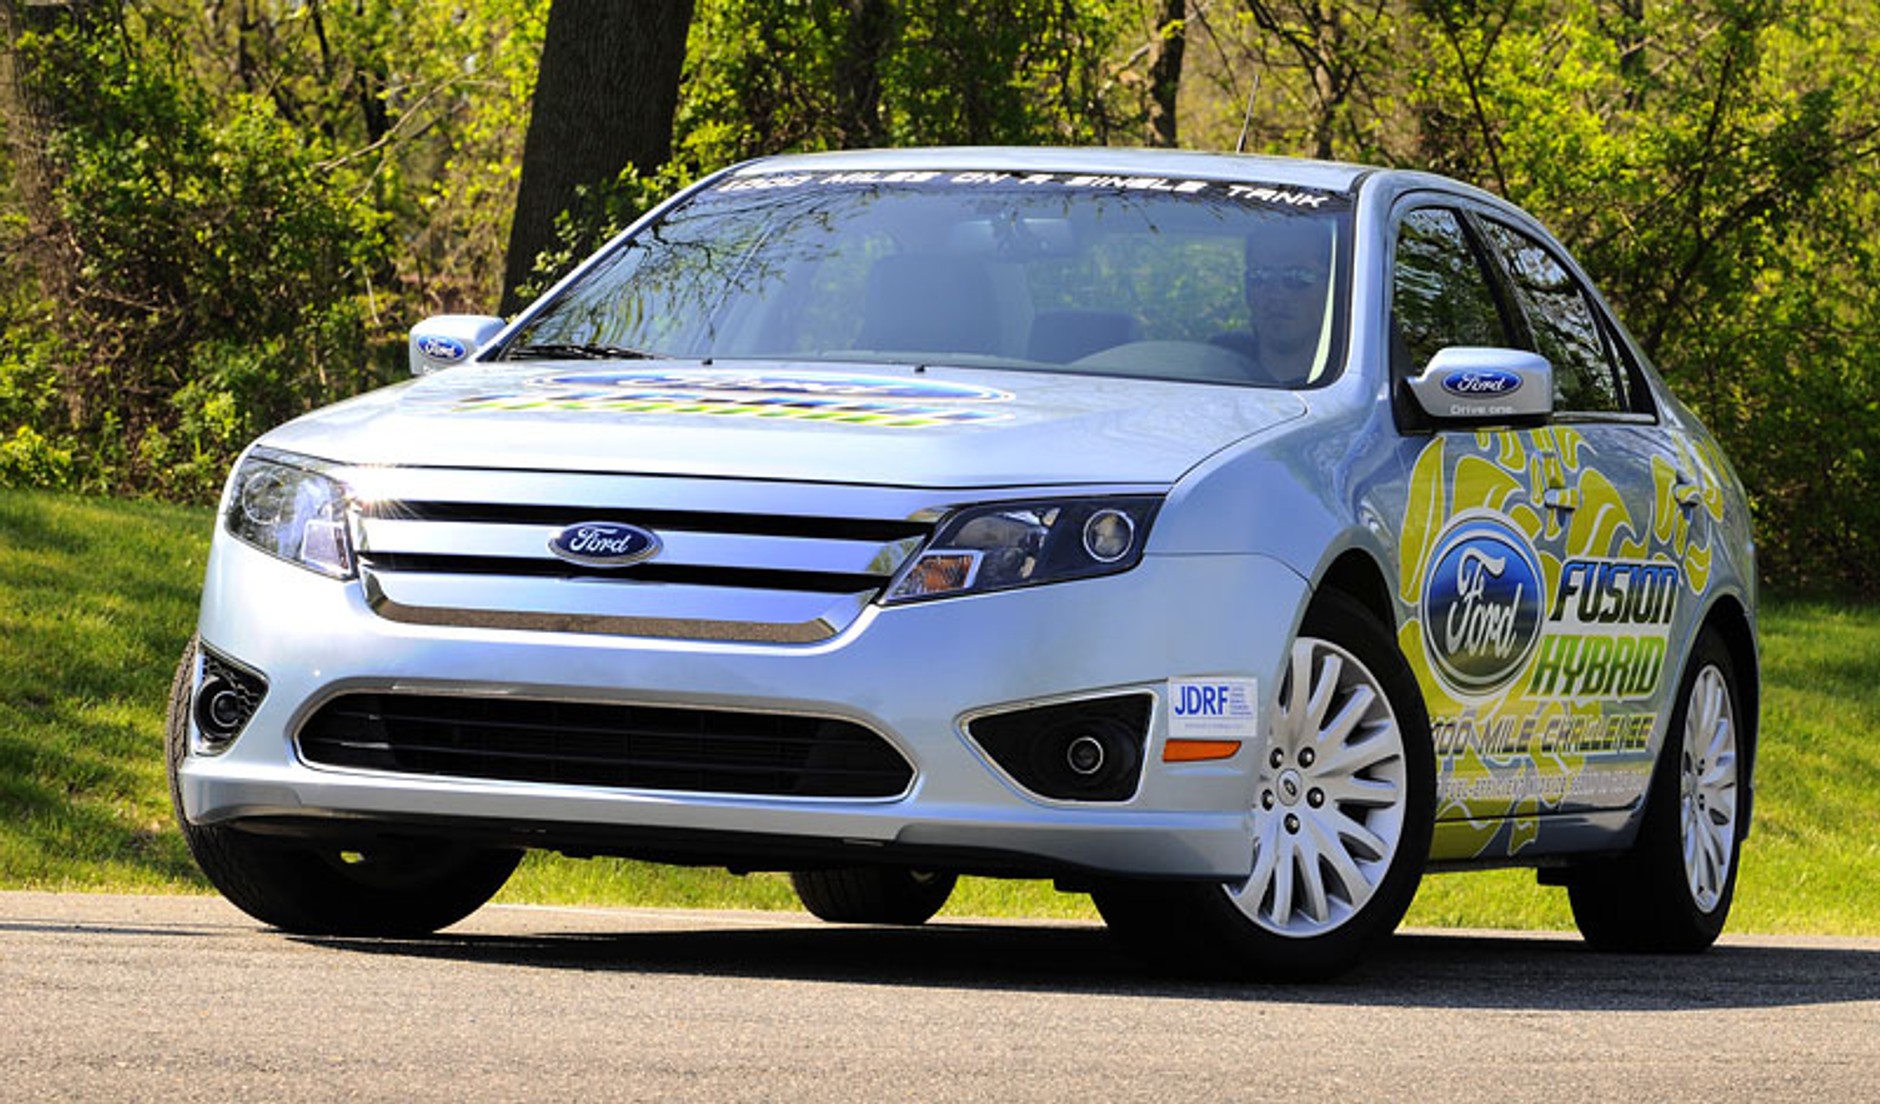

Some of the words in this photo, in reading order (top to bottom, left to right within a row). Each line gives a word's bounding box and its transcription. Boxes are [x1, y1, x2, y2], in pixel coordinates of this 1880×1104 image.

[819, 171, 942, 185] MILES
[951, 172, 1011, 184] ON
[1018, 174, 1054, 185] A
[1064, 176, 1209, 193] SINGLE
[1228, 185, 1329, 208] TANK
[1457, 372, 1505, 391] Ford
[1450, 403, 1487, 416] Drive
[569, 527, 632, 553] Ford
[1445, 546, 1524, 661] Ford
[1550, 560, 1680, 624] FUSION
[1527, 635, 1667, 698] HYBRID
[1174, 685, 1230, 716] JDRF
[1478, 715, 1538, 759] MILE
